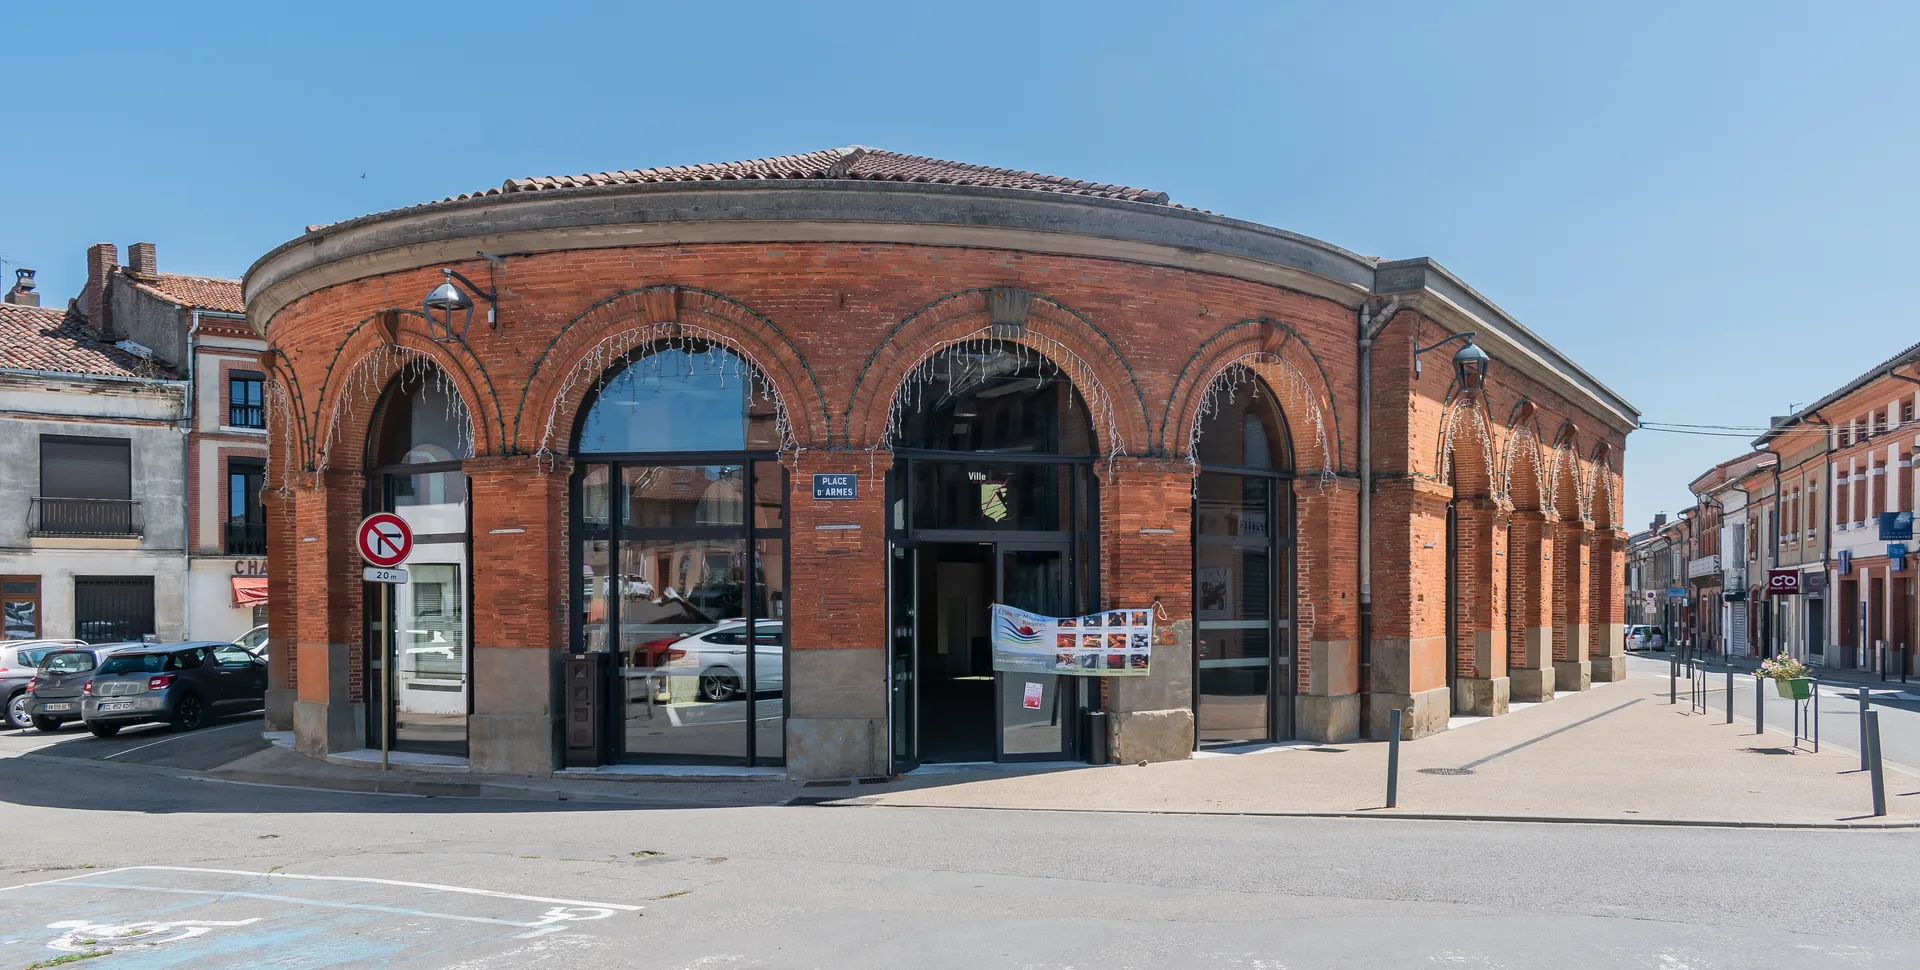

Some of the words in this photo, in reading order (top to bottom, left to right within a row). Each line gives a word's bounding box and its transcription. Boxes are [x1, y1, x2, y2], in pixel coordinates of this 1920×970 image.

[968, 471, 987, 481] Ville
[822, 477, 848, 486] PLACE
[376, 571, 390, 580] 20
